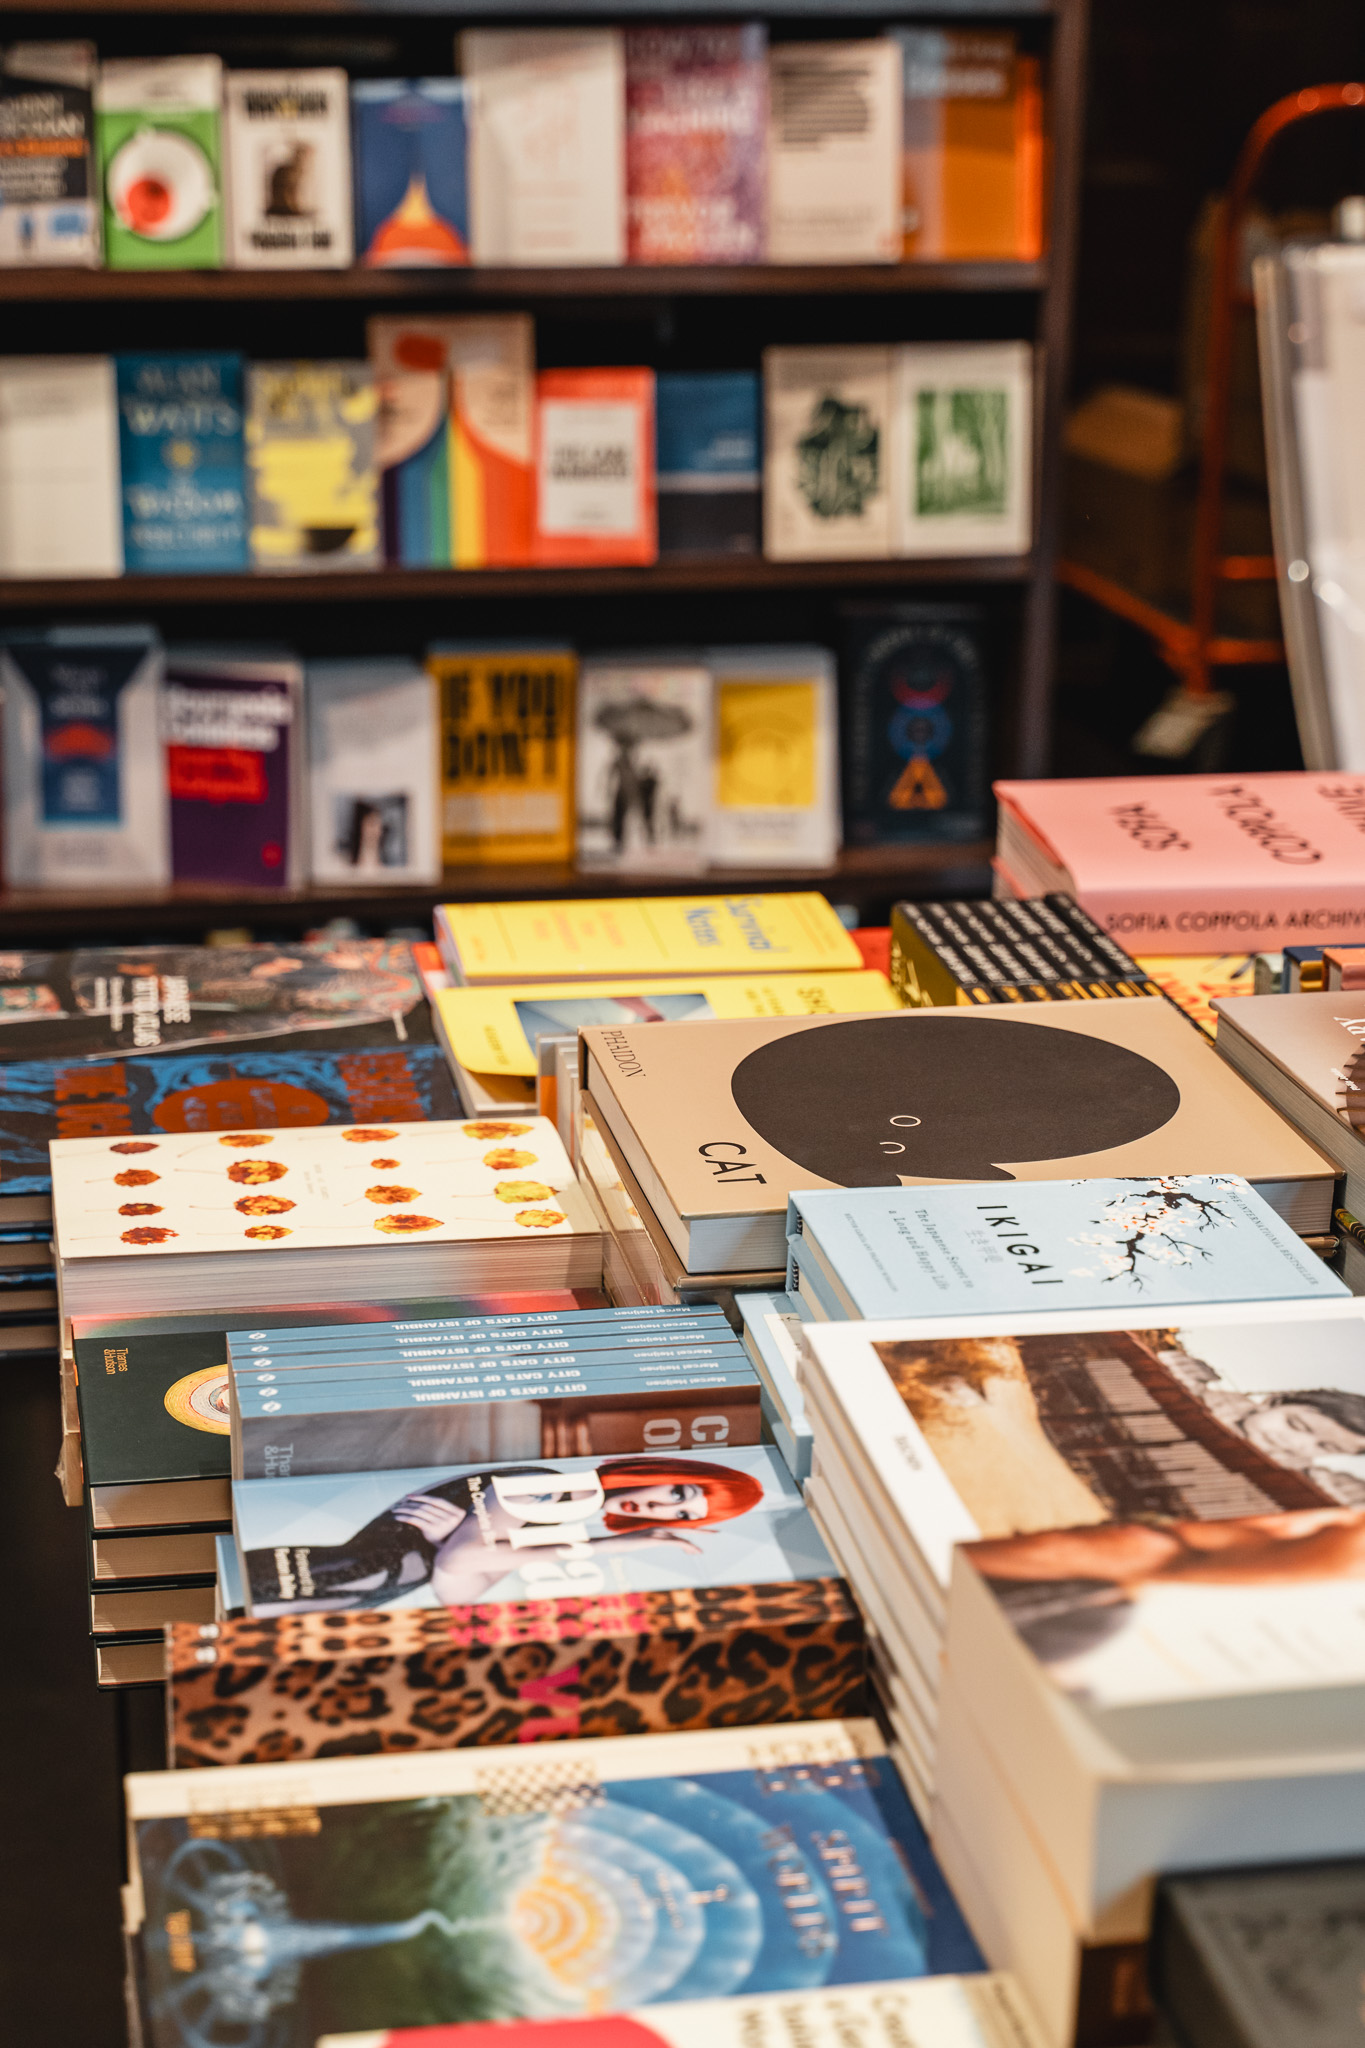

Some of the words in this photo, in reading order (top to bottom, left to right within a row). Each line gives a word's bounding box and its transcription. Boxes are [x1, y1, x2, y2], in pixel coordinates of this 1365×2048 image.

[1105, 912, 1170, 933] SOFIA
[1175, 910, 1278, 932] COPPOLA
[601, 1030, 646, 1078] PHAIDON
[697, 1140, 767, 1186] CAT
[893, 1217, 911, 1234] Long
[906, 1235, 923, 1250] and
[915, 1246, 937, 1274] Happy
[914, 1209, 929, 1221] The
[922, 1221, 951, 1255] Japanese
[946, 1254, 966, 1280] Secret
[976, 1205, 1064, 1285] IKIGAI
[462, 1319, 482, 1327] OF
[484, 1317, 522, 1325] CATS
[526, 1314, 558, 1322] CITY
[391, 1319, 460, 1331] ISTANBUL
[468, 1332, 486, 1340] OF
[492, 1330, 526, 1338] CATS
[532, 1328, 564, 1336] CITY
[394, 1333, 464, 1344] ISTANBUL
[473, 1346, 492, 1354] OF
[494, 1344, 532, 1352] CATS
[537, 1341, 570, 1349] CITY
[398, 1347, 470, 1358] ISTANBUL
[104, 1349, 117, 1375] &Hudson
[116, 1348, 129, 1372] Thames
[478, 1360, 496, 1369] OF
[501, 1358, 538, 1367] CATS
[543, 1355, 576, 1365] CITY
[404, 1361, 475, 1373] ISTANBUL
[483, 1374, 501, 1383] OF
[504, 1372, 542, 1382] CATS
[548, 1369, 581, 1379] CITY
[408, 1375, 479, 1387] ISTANBUL
[488, 1388, 507, 1398] OF
[510, 1385, 548, 1396] CATS
[553, 1383, 587, 1394] CITY
[412, 1389, 484, 1402] ISTANBUL
[264, 1445, 279, 1479] &Hu
[467, 1476, 482, 1492] The
